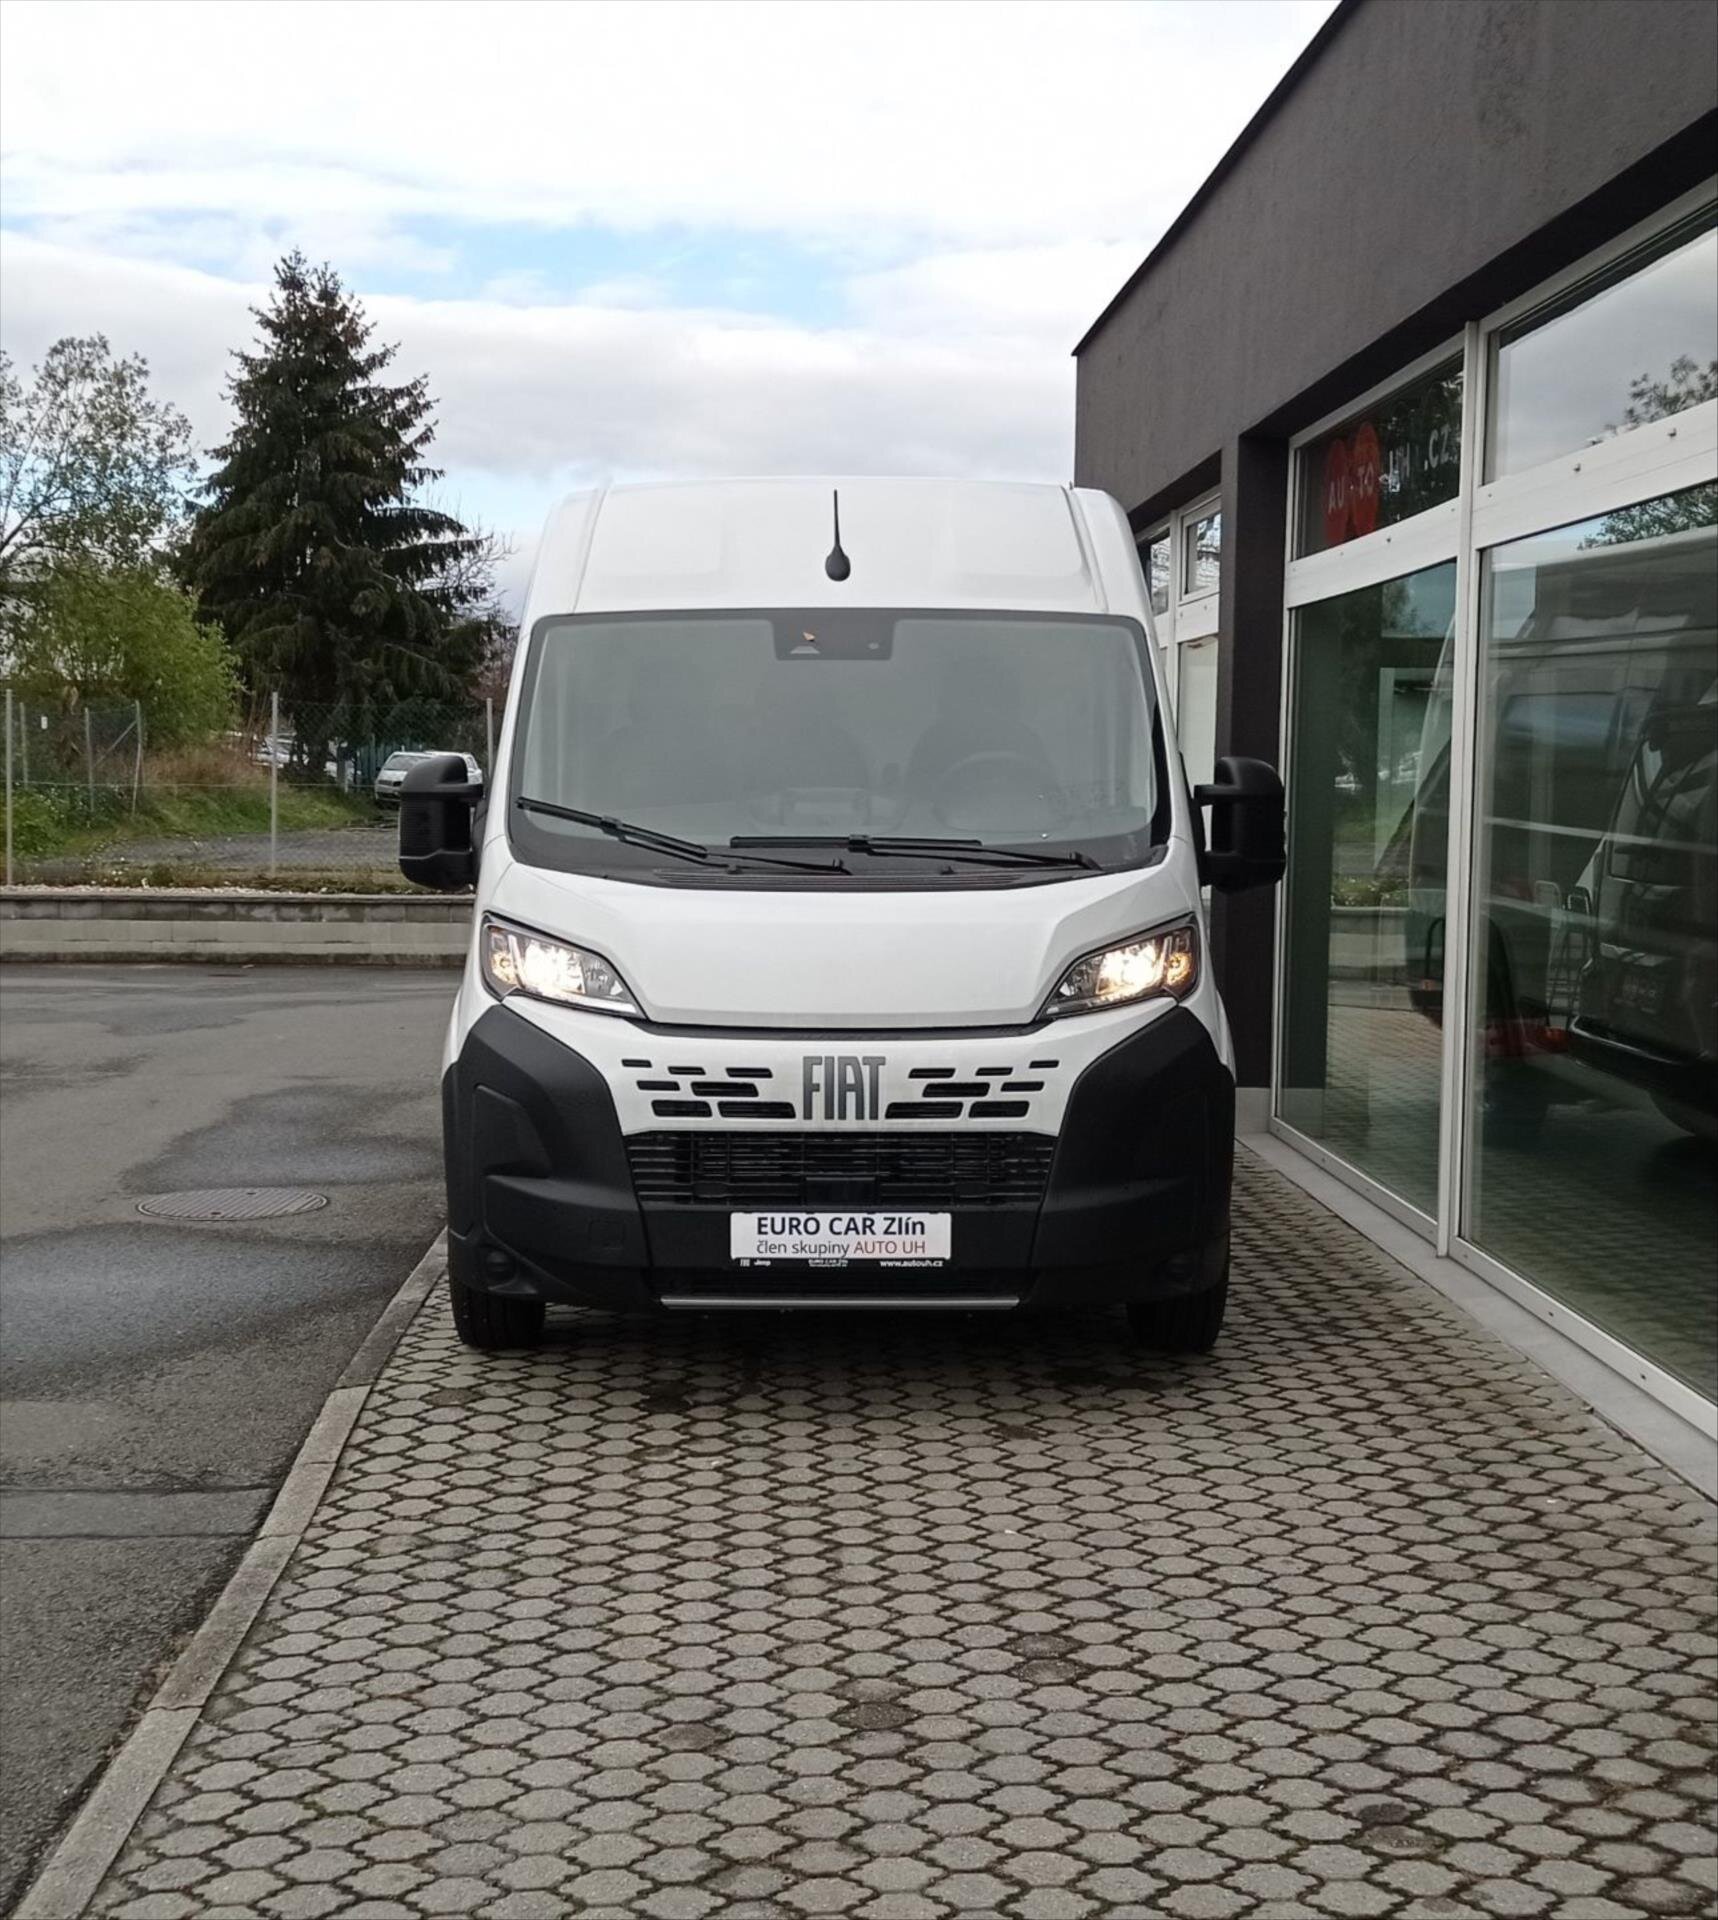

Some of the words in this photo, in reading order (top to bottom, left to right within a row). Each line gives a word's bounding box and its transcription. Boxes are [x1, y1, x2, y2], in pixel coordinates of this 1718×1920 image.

[803, 1055, 886, 1120] FIAT
[756, 1217, 820, 1236] EURO
[828, 1217, 876, 1236] CAR
[882, 1216, 926, 1236] Zlín
[756, 1239, 787, 1255] člen
[791, 1240, 850, 1258] skupiny
[853, 1240, 897, 1255] AUTO
[902, 1240, 926, 1255] UH
[879, 1259, 944, 1268] www.autouh.cz
